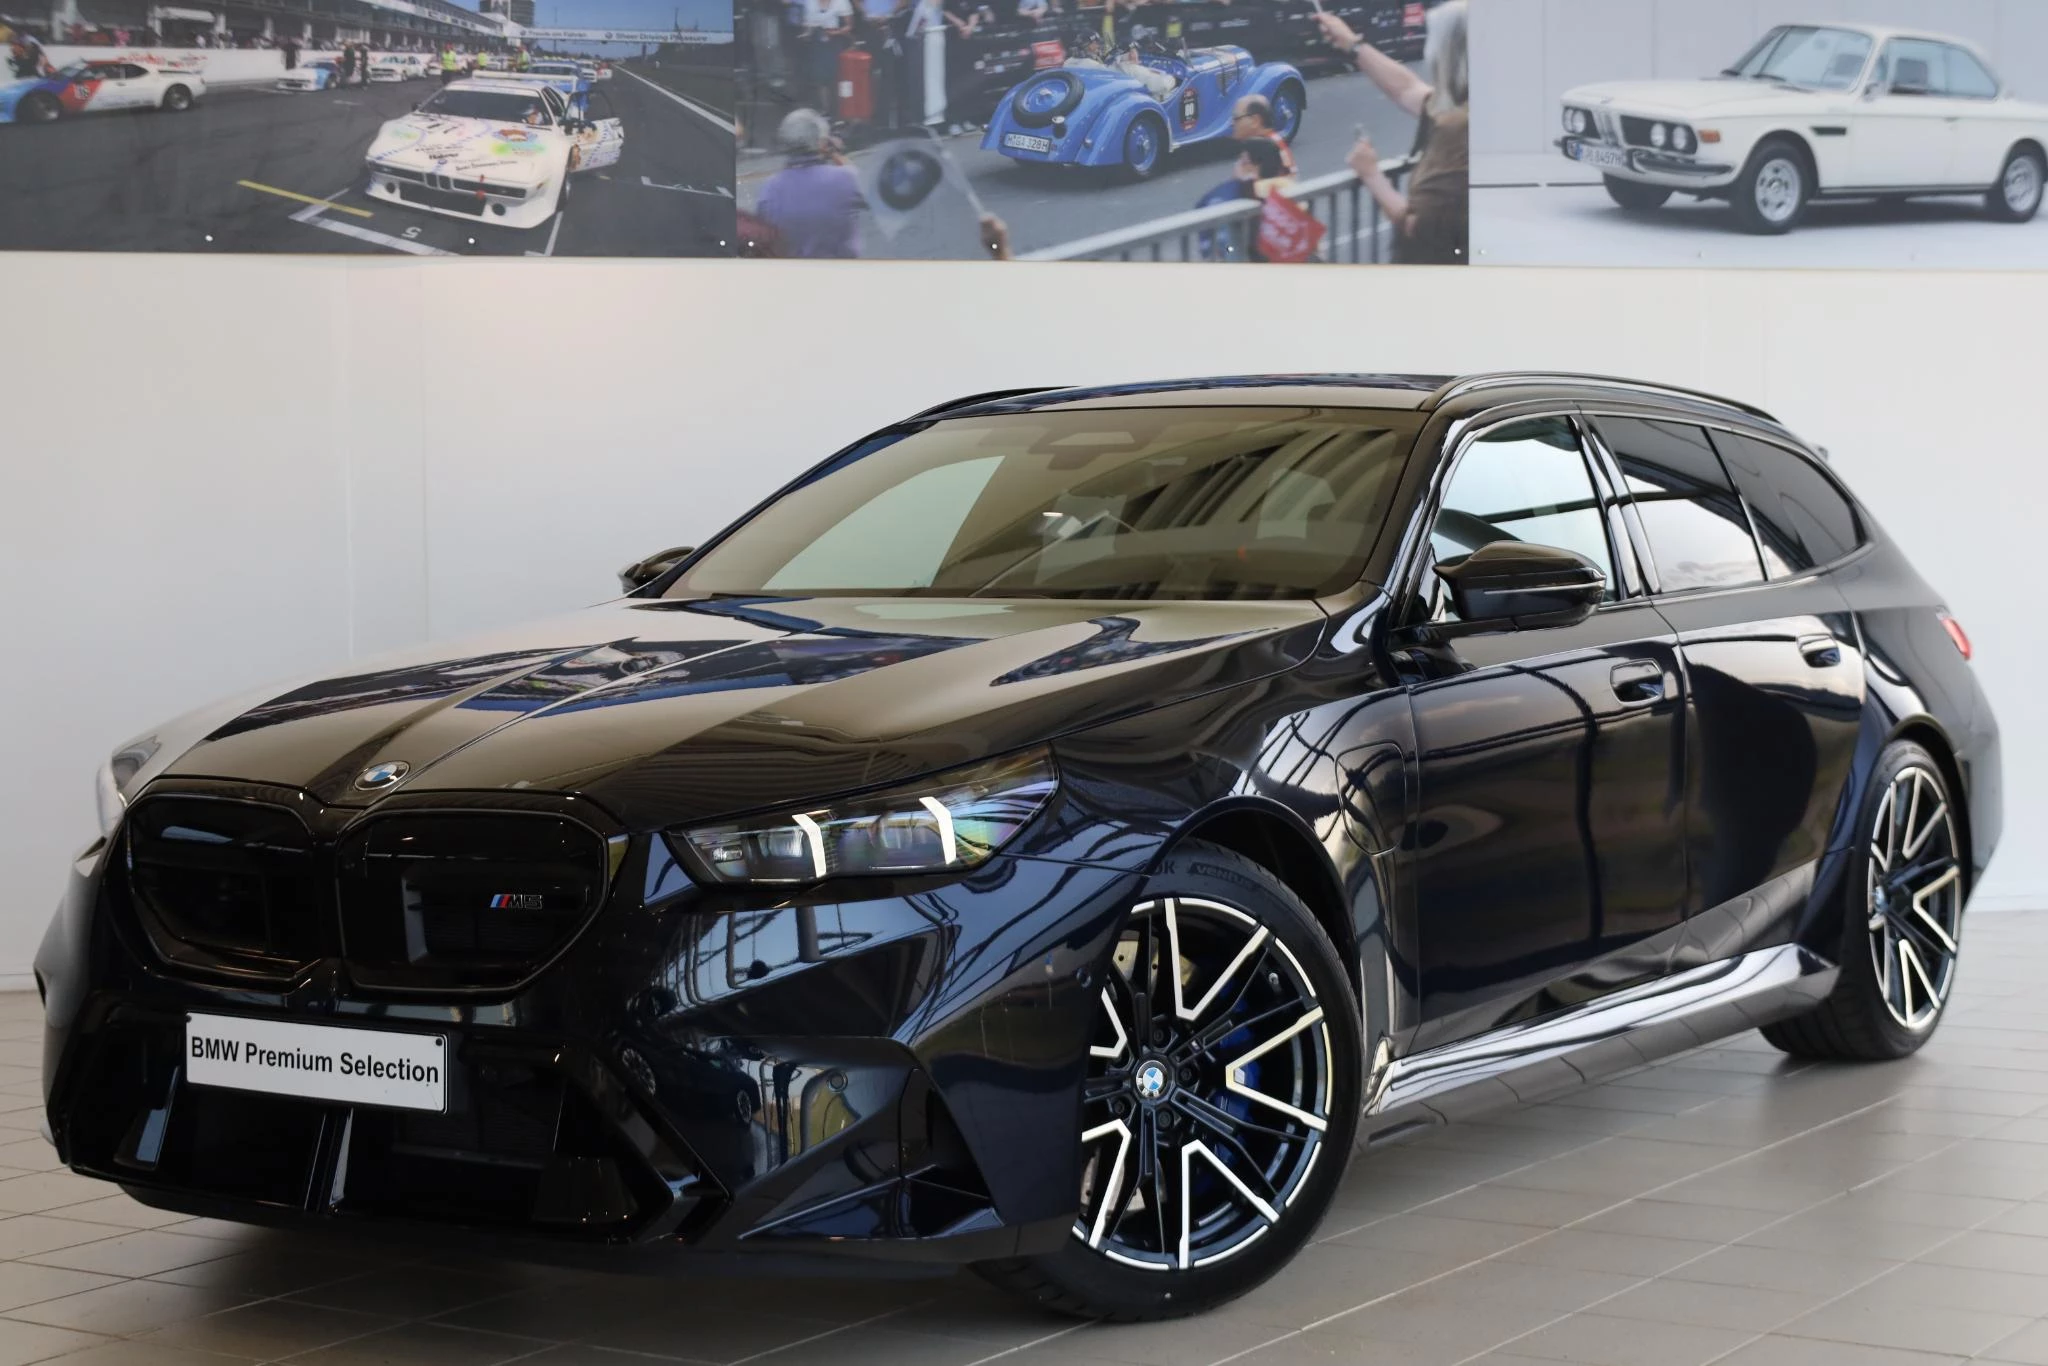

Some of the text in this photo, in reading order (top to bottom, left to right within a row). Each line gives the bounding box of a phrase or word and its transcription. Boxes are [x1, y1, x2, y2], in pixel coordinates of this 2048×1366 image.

[190, 1035, 439, 1084] BMW Premium Selection
